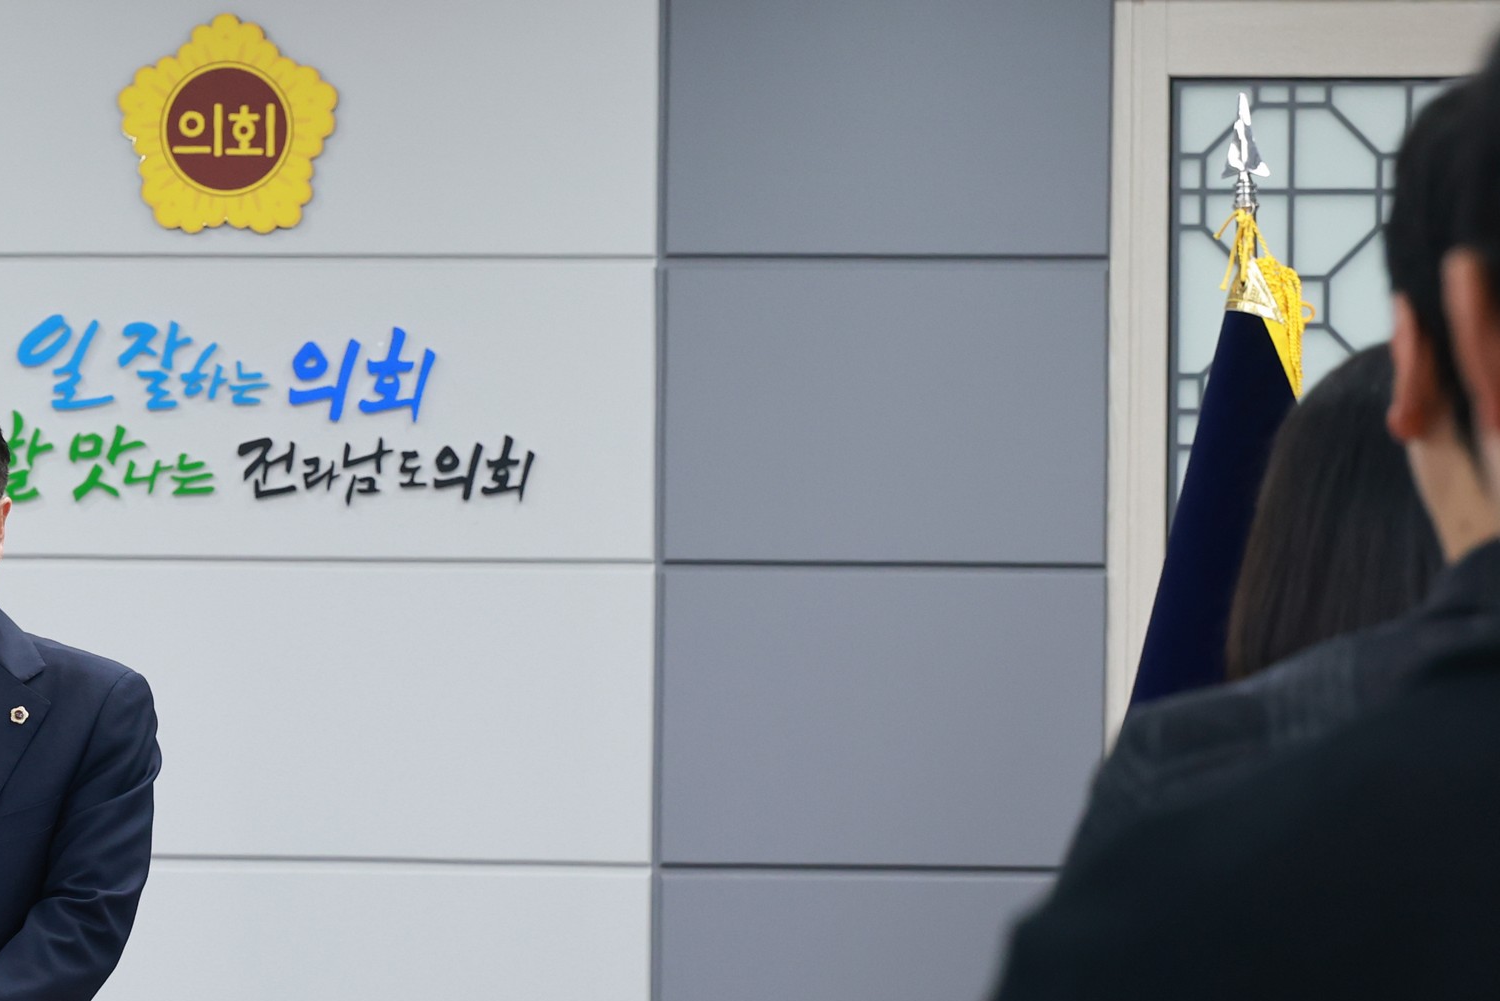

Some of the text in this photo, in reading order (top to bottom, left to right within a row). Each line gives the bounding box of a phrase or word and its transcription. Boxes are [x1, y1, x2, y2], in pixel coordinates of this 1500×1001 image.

[172, 103, 276, 158] 의회
[16, 314, 437, 423] 일 잘하는 의회
[69, 425, 216, 502] 맛나는
[237, 435, 535, 506] 전라남도의회
